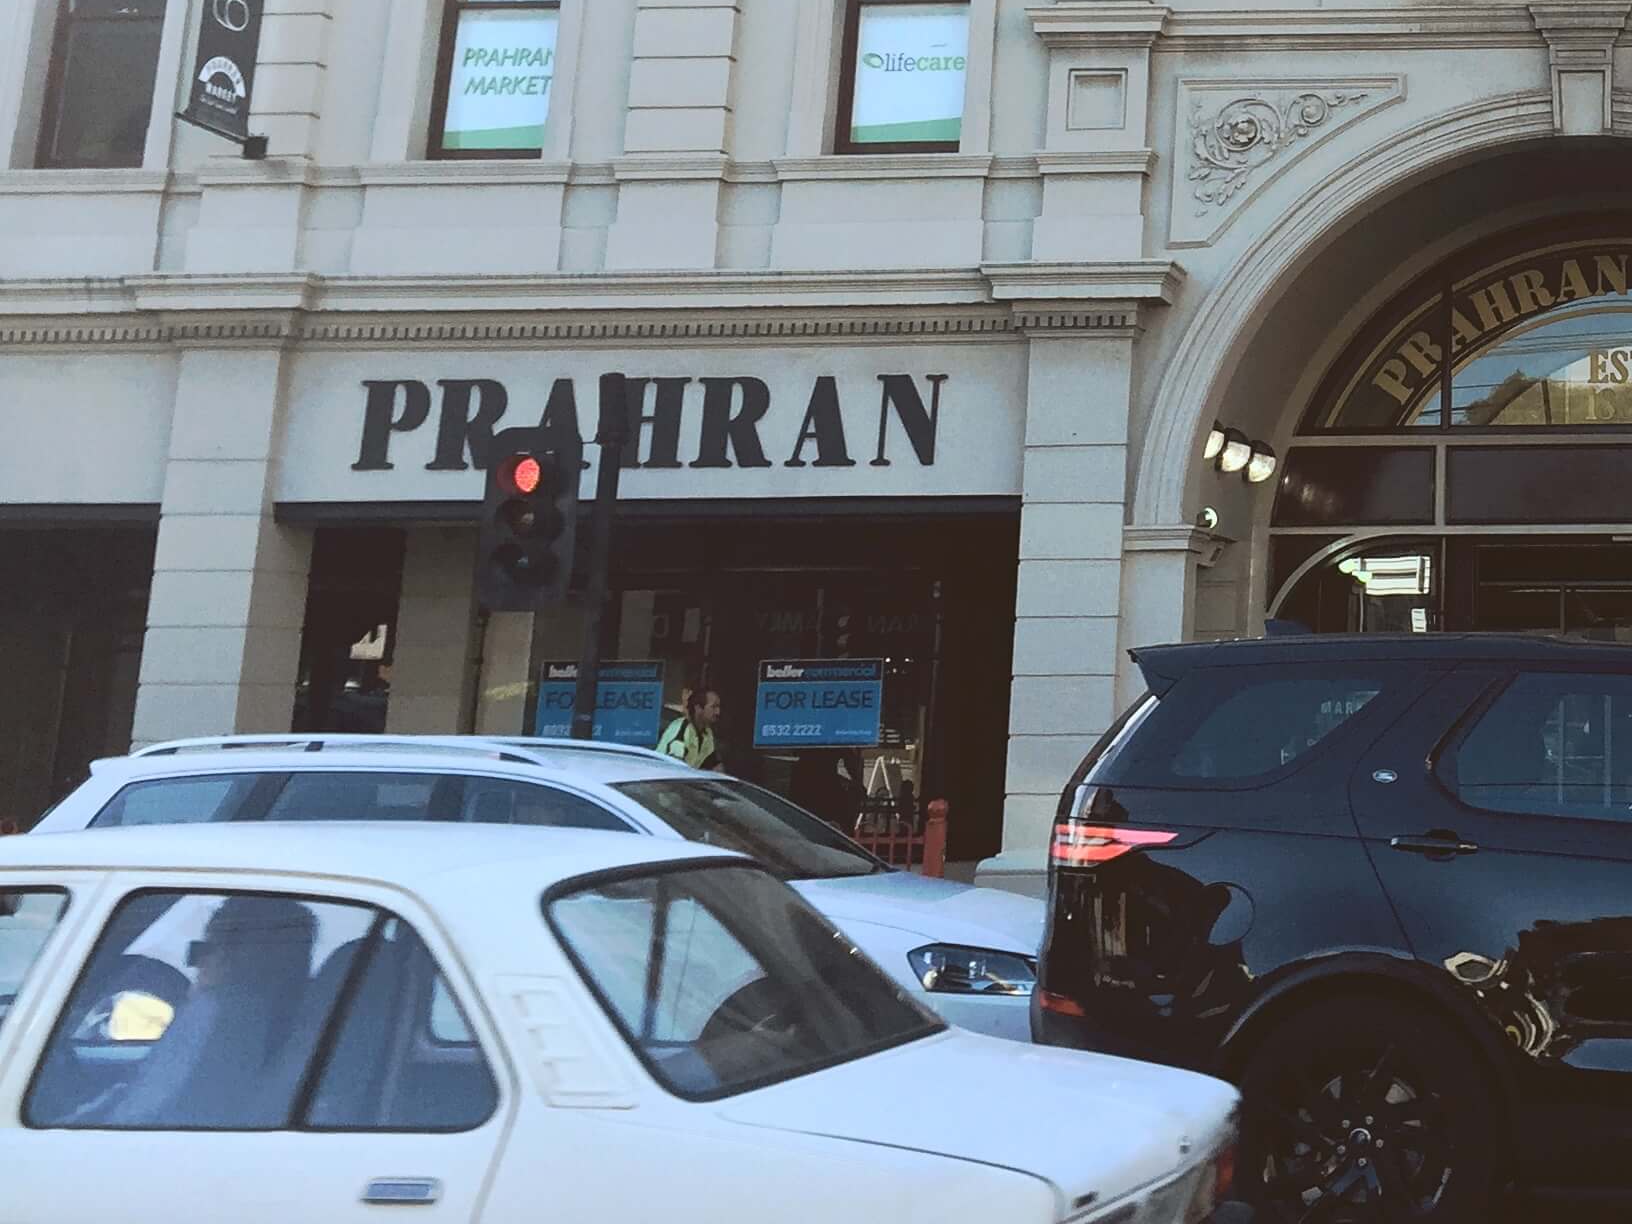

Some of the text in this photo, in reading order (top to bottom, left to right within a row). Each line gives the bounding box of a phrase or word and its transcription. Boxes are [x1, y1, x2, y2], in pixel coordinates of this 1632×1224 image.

[884, 52, 967, 72] lifecare
[464, 75, 553, 96] MARKET
[1372, 255, 1629, 406] PRAHRAN
[351, 373, 948, 472] PRAHRAN
[545, 690, 578, 710] FO
[763, 690, 874, 711] FOR LEASE
